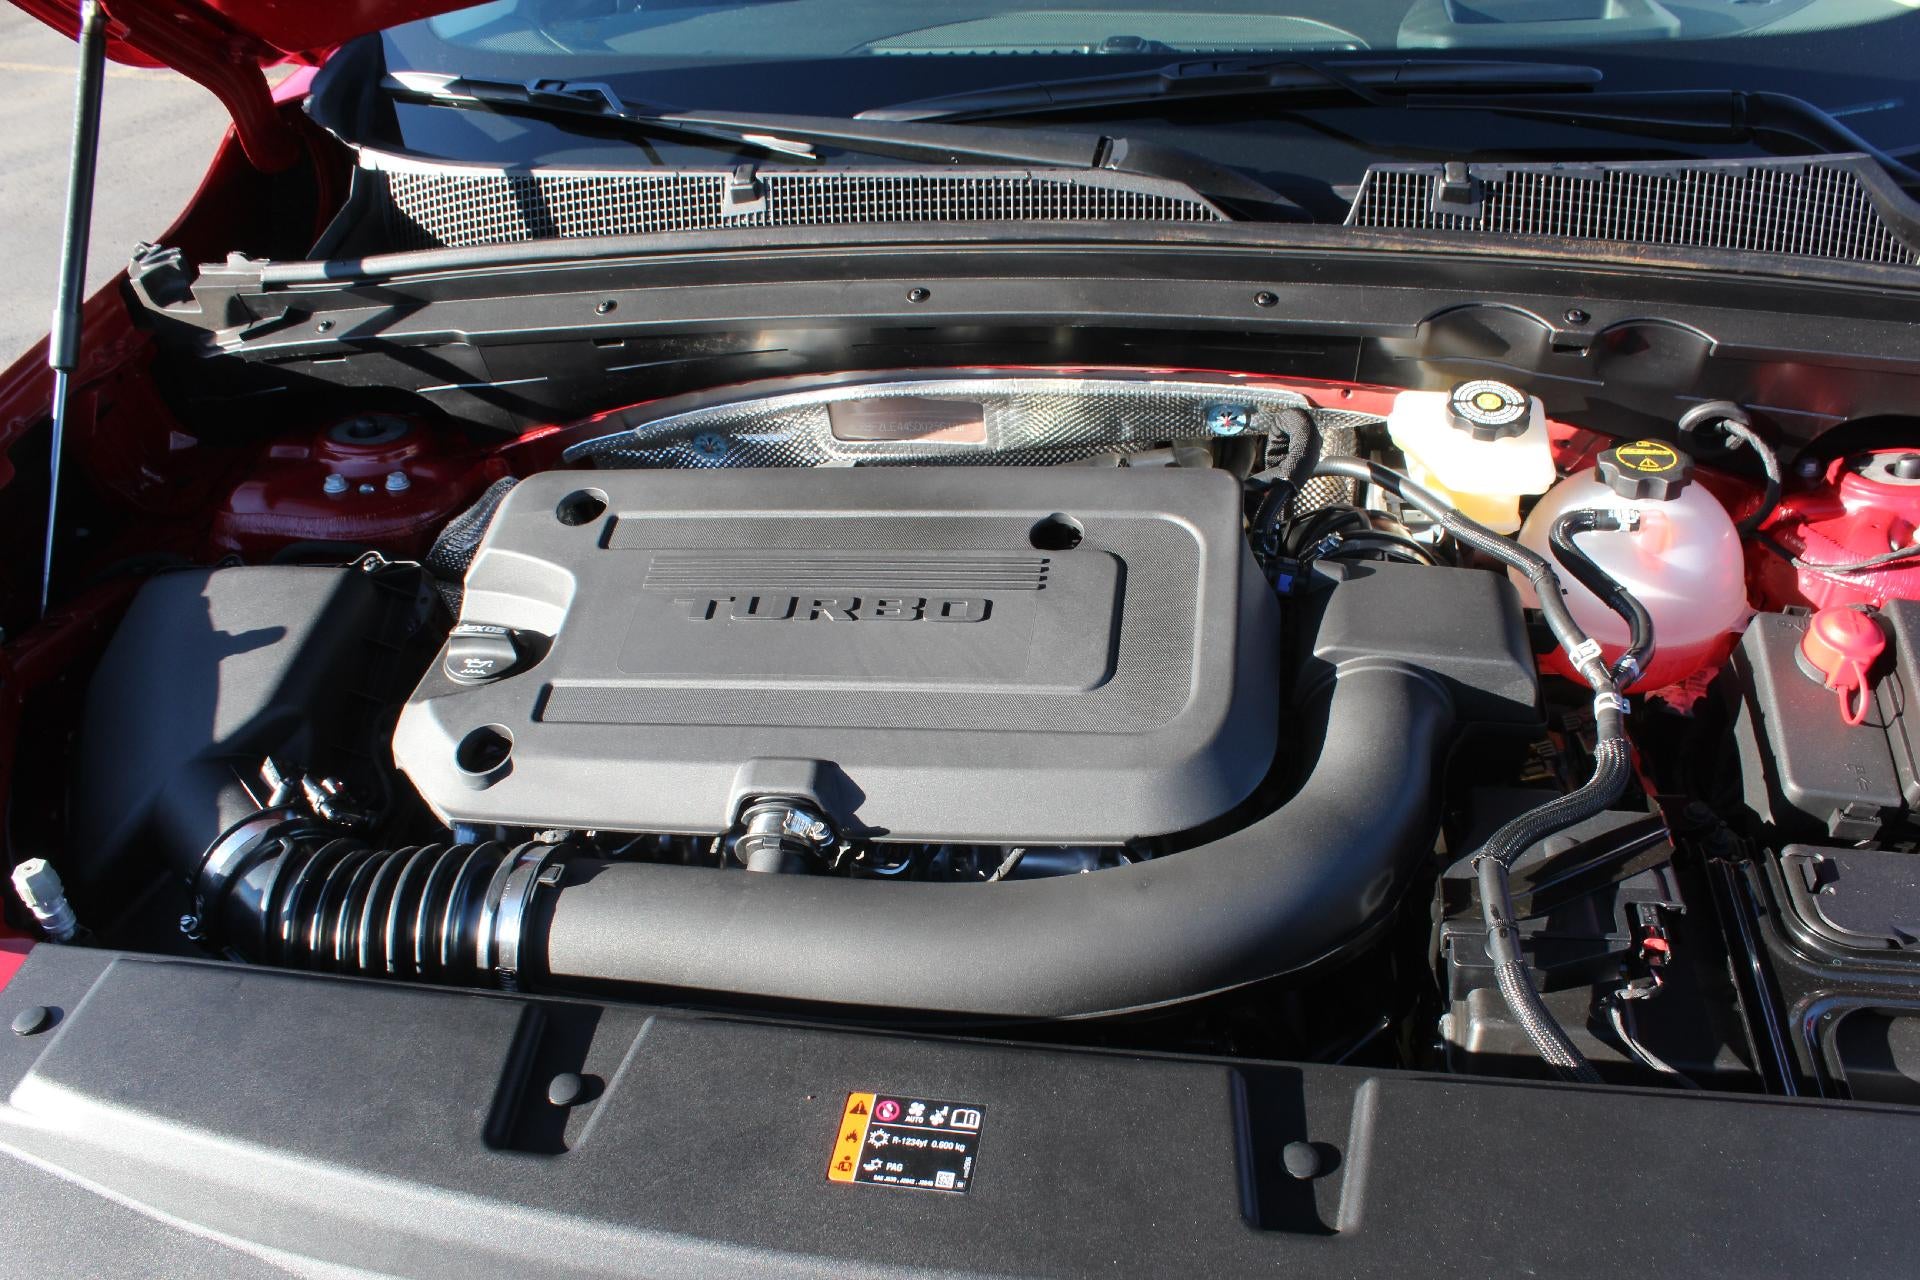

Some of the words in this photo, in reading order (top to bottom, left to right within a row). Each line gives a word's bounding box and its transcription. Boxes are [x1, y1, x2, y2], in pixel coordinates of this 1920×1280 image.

[674, 596, 994, 623] TURBO
[905, 1115, 924, 1125] AUTO
[891, 1136, 928, 1149] R-1234yf
[954, 1141, 967, 1153] kg
[886, 1161, 904, 1172] PAG
